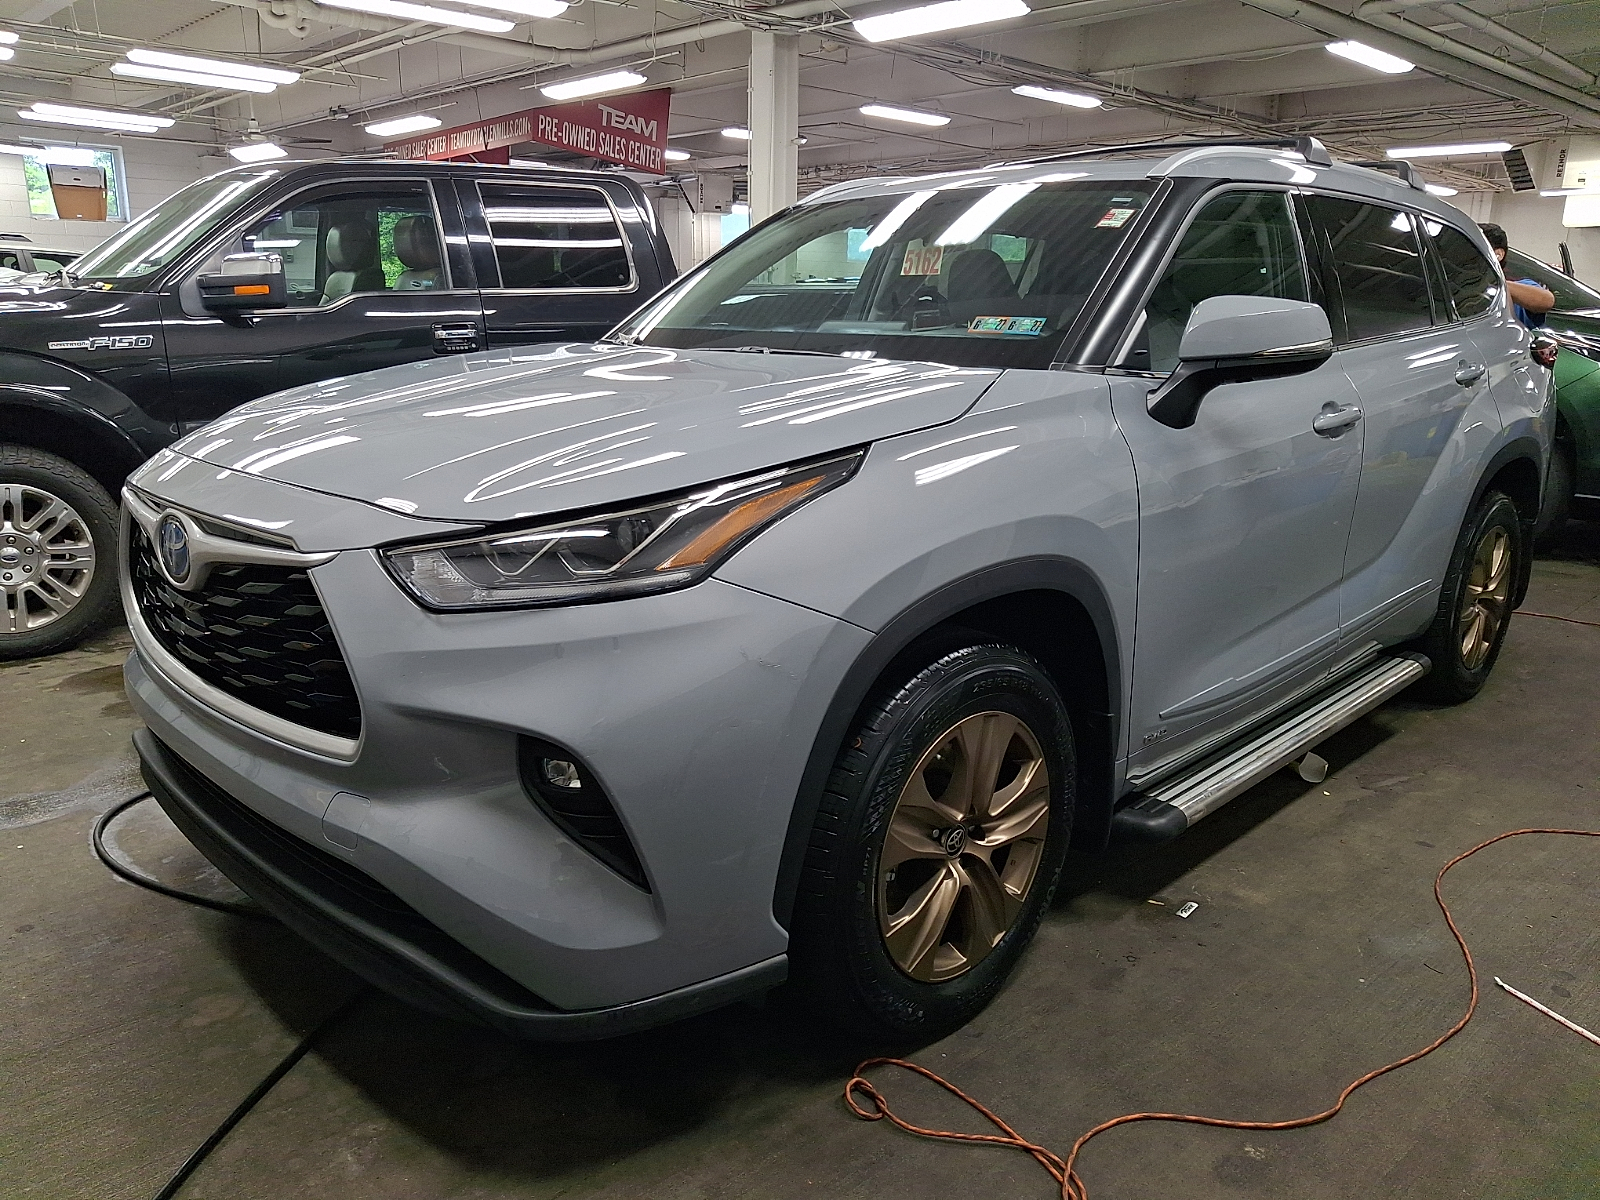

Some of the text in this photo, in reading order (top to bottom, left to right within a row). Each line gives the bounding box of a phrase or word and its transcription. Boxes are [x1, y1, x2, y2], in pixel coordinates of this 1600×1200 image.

[597, 103, 658, 142] TEAM
[427, 135, 447, 155] CENTER
[538, 114, 662, 170] PRE-OWNED SALES CENTER
[1556, 148, 1567, 178] REZNOR
[903, 246, 942, 275] 5162
[88, 335, 154, 350] F-150
